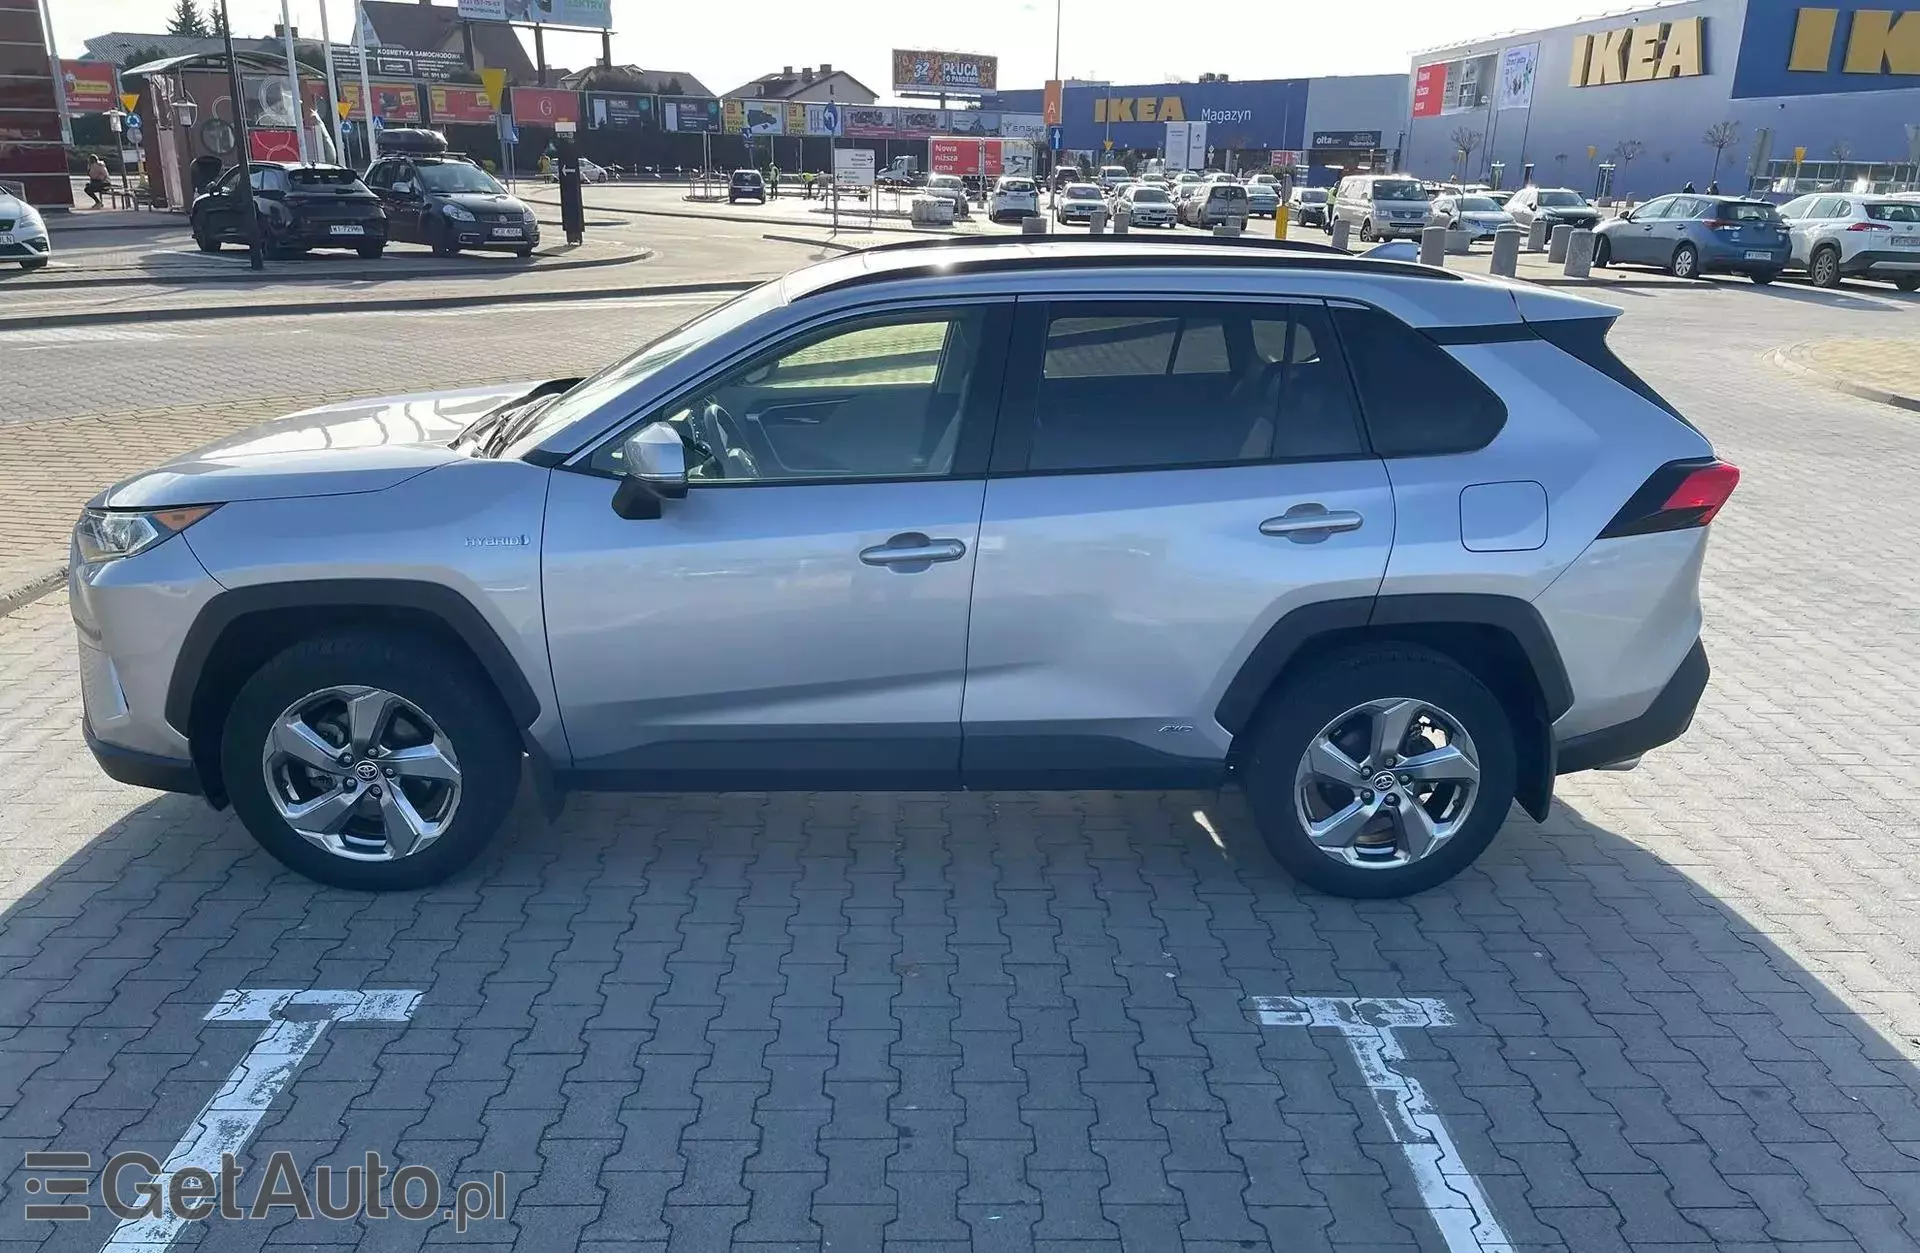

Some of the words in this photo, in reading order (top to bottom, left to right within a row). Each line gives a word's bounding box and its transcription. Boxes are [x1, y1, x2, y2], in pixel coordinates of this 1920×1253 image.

[1788, 8, 1920, 75] IK
[377, 48, 414, 57] KOSMETYKA
[1569, 16, 1705, 88] IKEA
[914, 61, 930, 78] 32
[943, 62, 978, 77] PŁUCA
[1047, 101, 1057, 114] A
[1095, 96, 1186, 123] IKEA
[1201, 108, 1251, 124] Magazyn
[935, 144, 957, 152] Nowa
[935, 154, 958, 162] niższa
[464, 536, 520, 547] HYBRID
